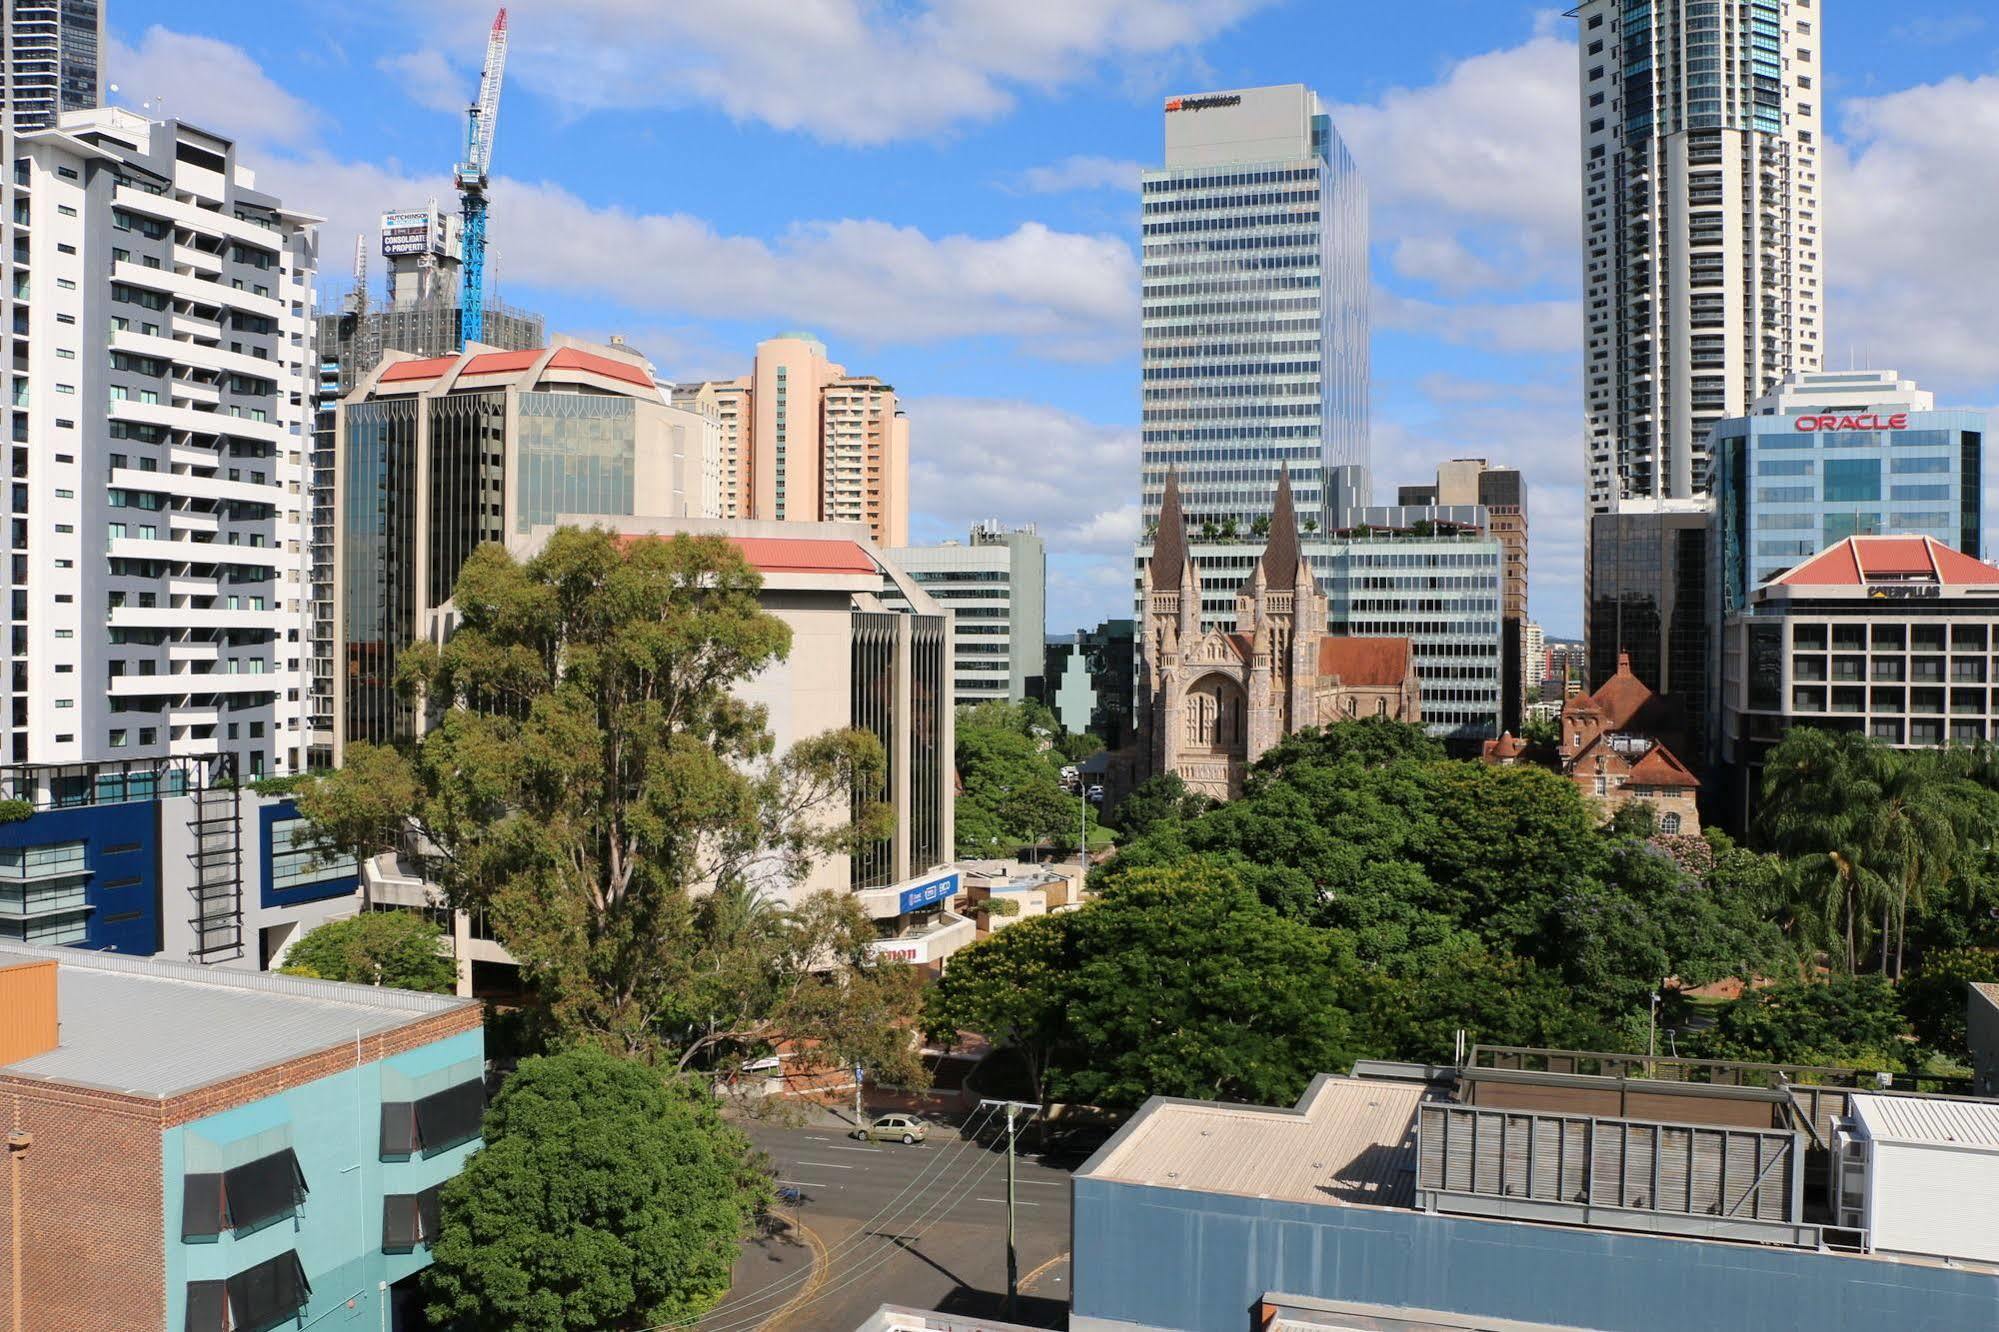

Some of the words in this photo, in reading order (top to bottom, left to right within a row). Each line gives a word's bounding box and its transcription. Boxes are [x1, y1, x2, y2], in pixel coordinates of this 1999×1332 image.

[385, 234, 427, 244] CONSOLIDATE
[1796, 413, 1907, 431] ORACLE
[1868, 586, 1940, 598] CATERPILLAR
